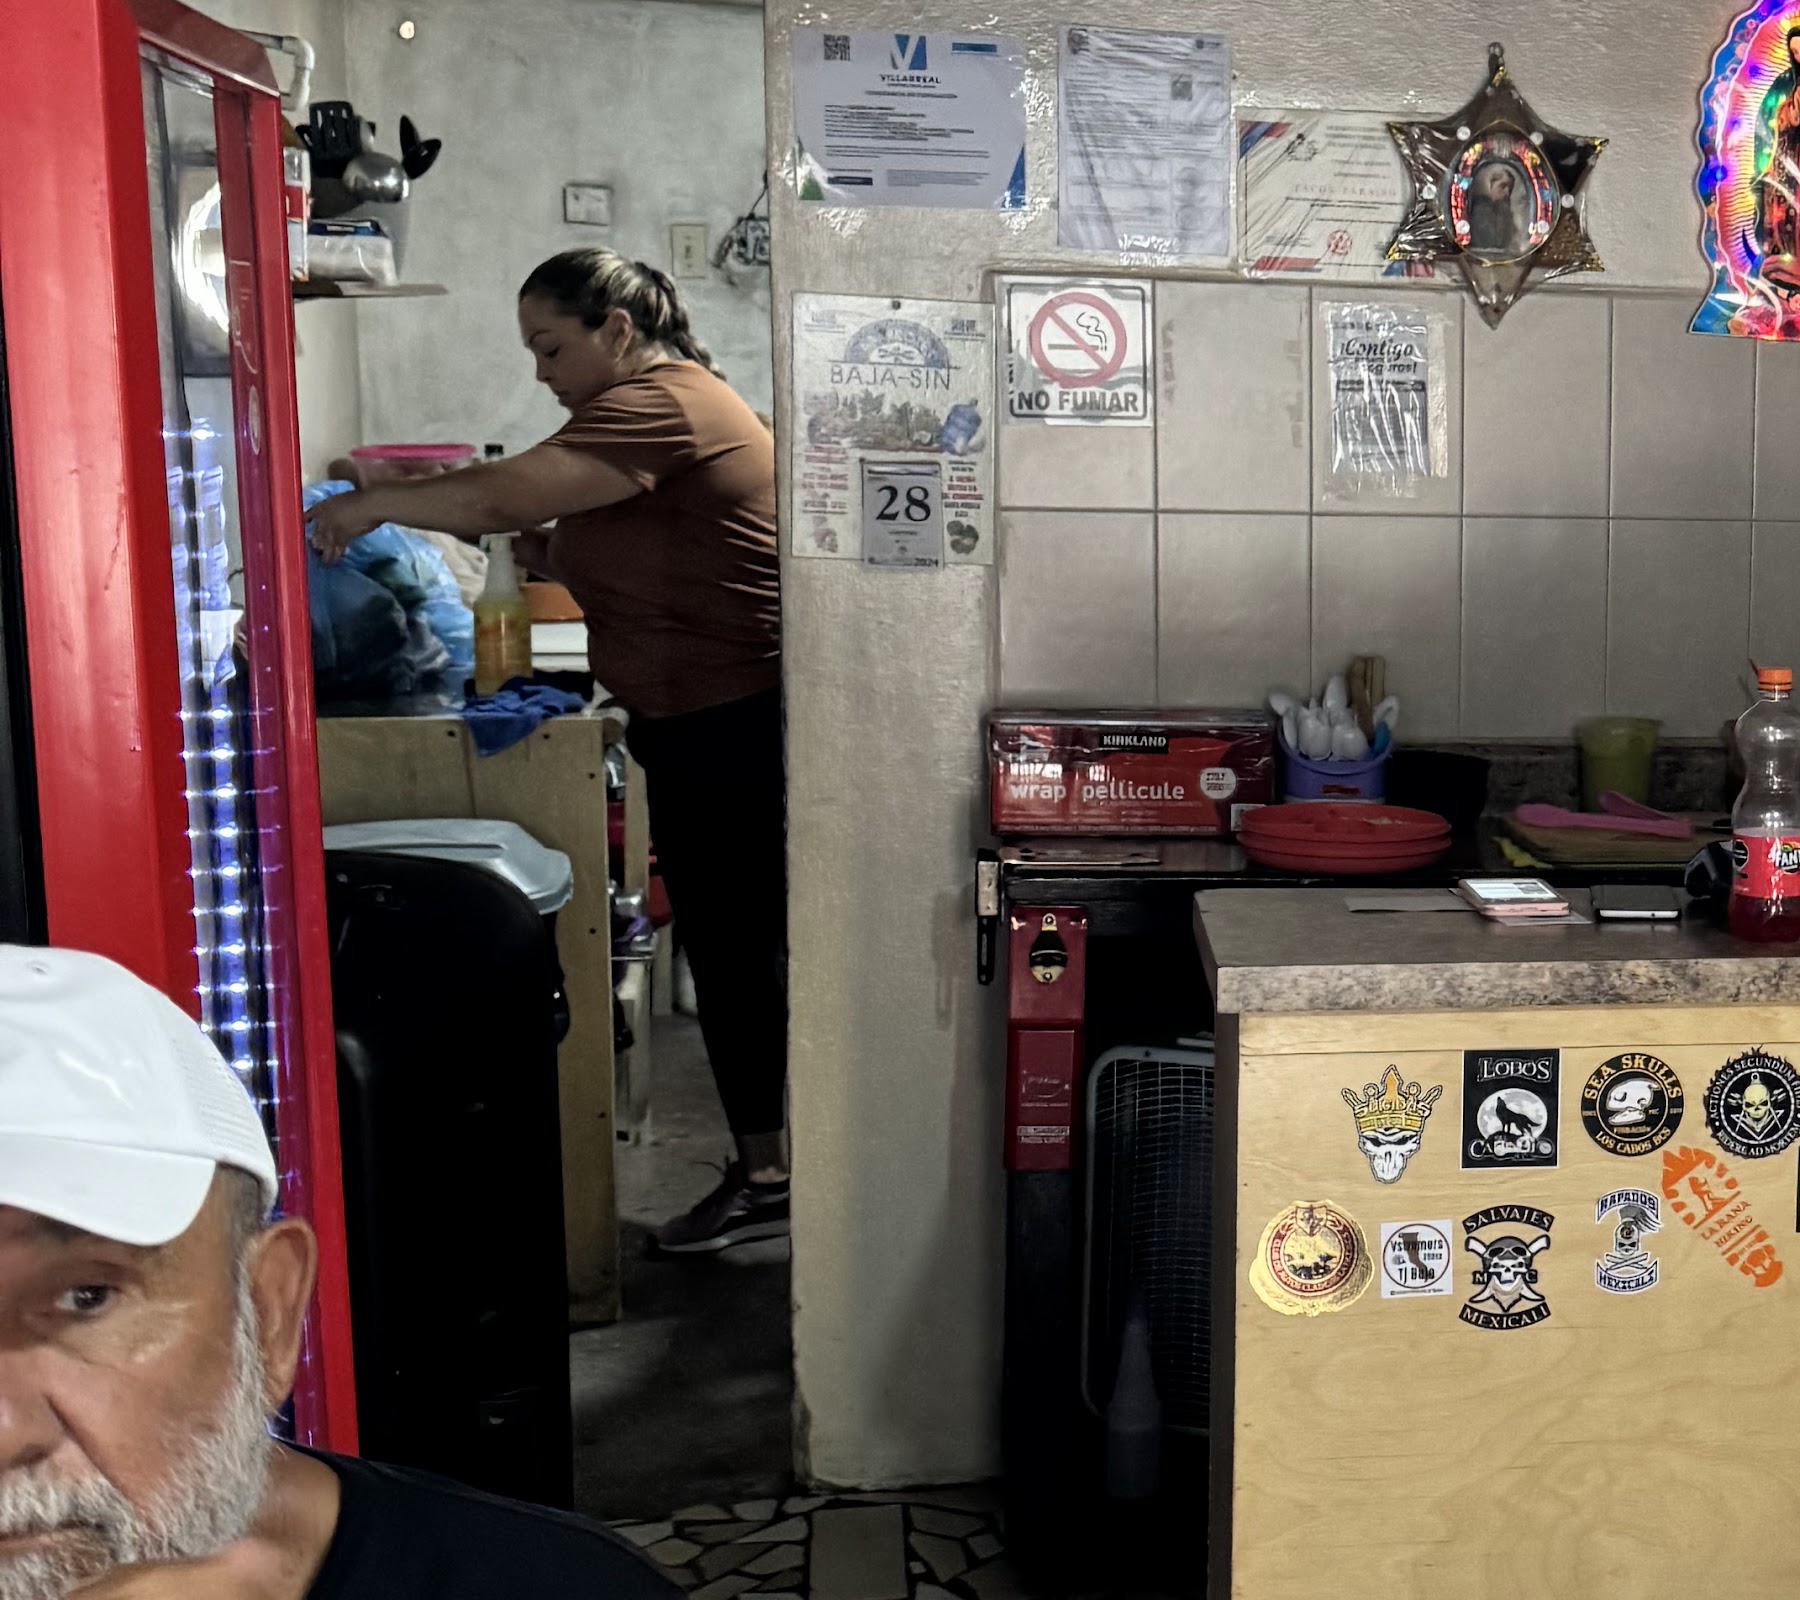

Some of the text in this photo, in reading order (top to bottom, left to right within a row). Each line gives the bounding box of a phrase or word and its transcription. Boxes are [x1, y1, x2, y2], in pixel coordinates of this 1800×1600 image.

[1017, 390, 1139, 412] NO FUMAR
[876, 485, 931, 522] 28
[914, 557, 938, 568] 2024
[1103, 734, 1167, 748] KIRKLAND
[1010, 784, 1066, 804] wrap
[1082, 777, 1185, 803] pellicule
[1482, 1059, 1550, 1079] LOBOS
[1584, 1054, 1682, 1101] SEA SKULLS
[1709, 1069, 1734, 1119] ACTIONES
[1734, 1057, 1795, 1081] SECUNDUM
[1595, 1126, 1671, 1154] LOS CABOS BCS
[1748, 1146, 1763, 1156] AD
[1764, 1122, 1800, 1153] MORTEM
[1600, 1191, 1656, 1212] RAPADOS
[1464, 1206, 1551, 1232] SALVAJES
[1701, 1201, 1752, 1240] LA RANA
[1390, 1238, 1444, 1253] Vsmers
[1474, 1271, 1488, 1283] M
[1598, 1269, 1655, 1290] MEXICALI
[1462, 1304, 1550, 1328] MEXICALI
